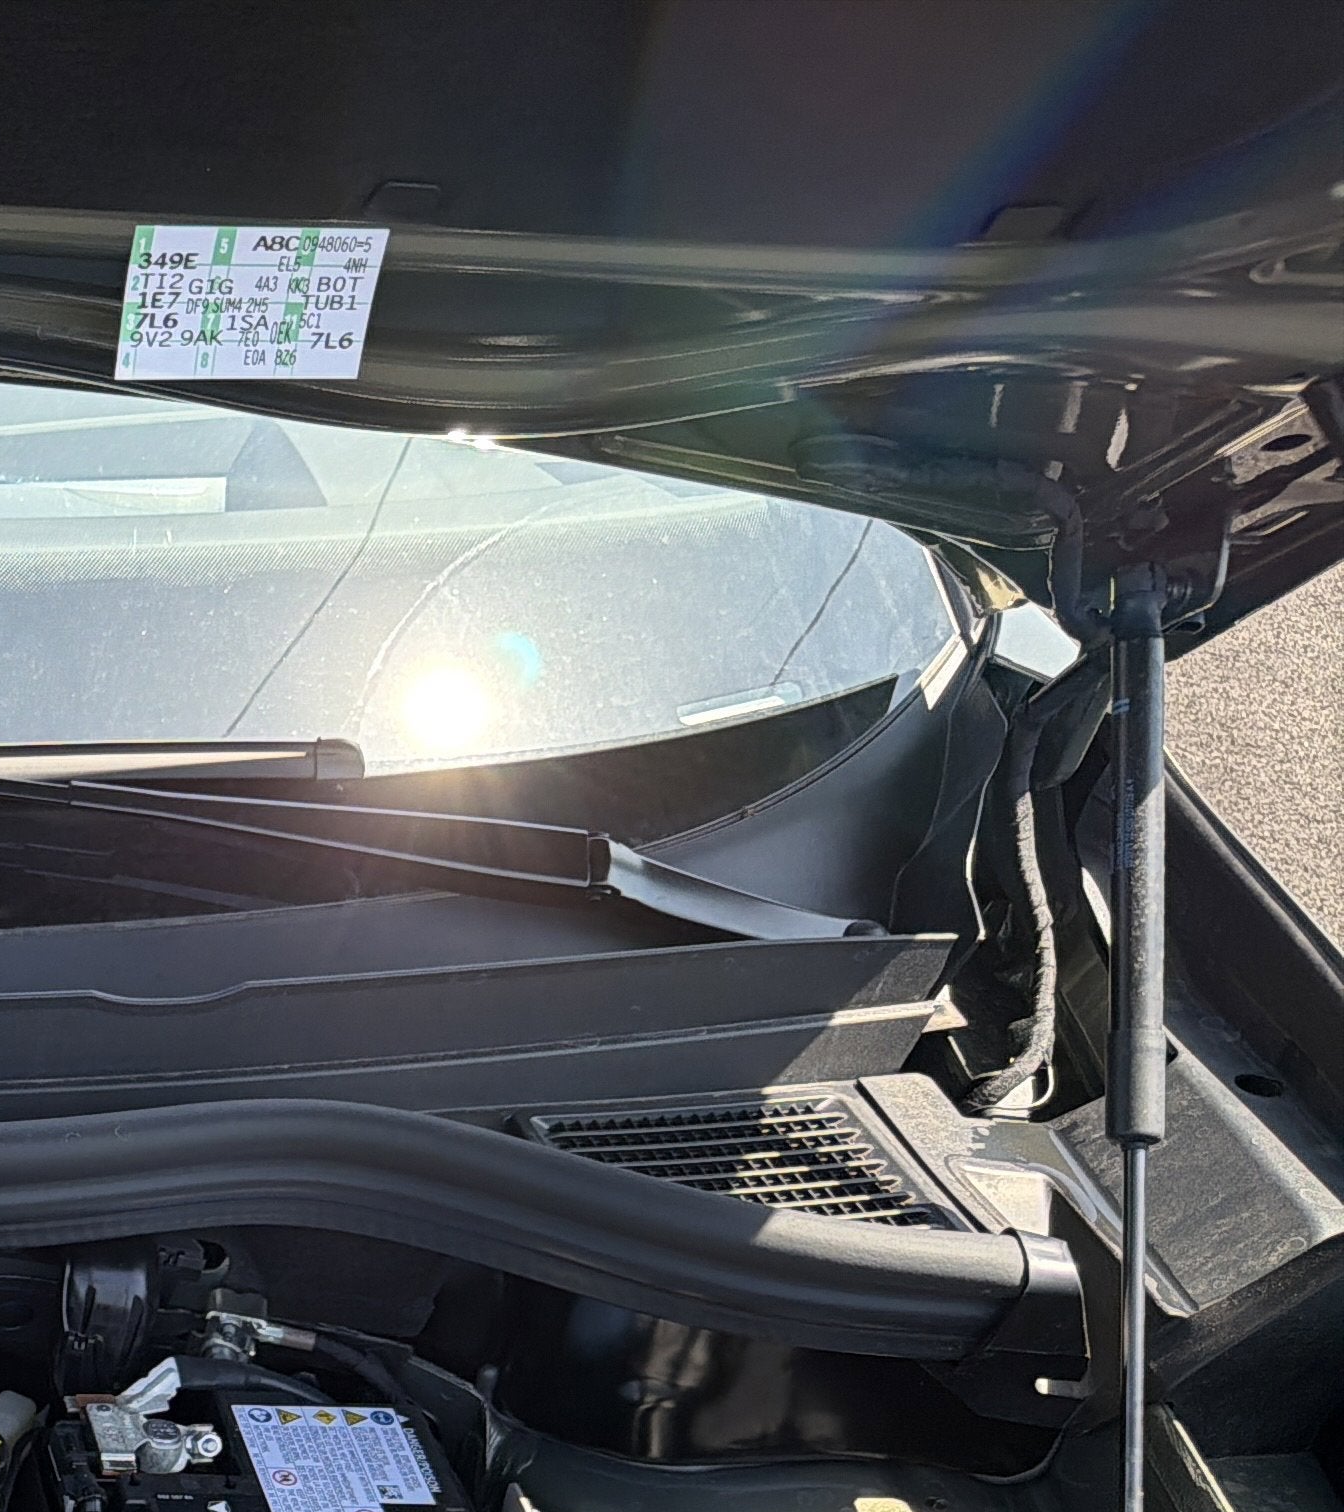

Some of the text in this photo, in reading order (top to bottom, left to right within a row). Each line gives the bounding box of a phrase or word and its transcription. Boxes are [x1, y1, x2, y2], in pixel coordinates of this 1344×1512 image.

[139, 238, 146, 252] 1
[220, 238, 229, 254] 5
[252, 236, 300, 252] A8C
[138, 252, 199, 269] 349E
[277, 256, 368, 273] EL5 4NH
[131, 275, 140, 291] 2
[255, 276, 278, 292] 4A3
[137, 292, 182, 309] 1E7
[185, 298, 210, 315] DF9
[245, 297, 269, 314] 2H5
[301, 294, 358, 310] TUB1
[134, 312, 178, 329] 7L6
[206, 314, 215, 329] 7
[226, 314, 269, 331] 1SA
[299, 313, 321, 329] 5C1
[130, 331, 173, 348] 9V2
[180, 330, 223, 346] 9AK
[310, 332, 354, 350] 7L6
[122, 352, 131, 368] 4
[200, 352, 209, 368] 8
